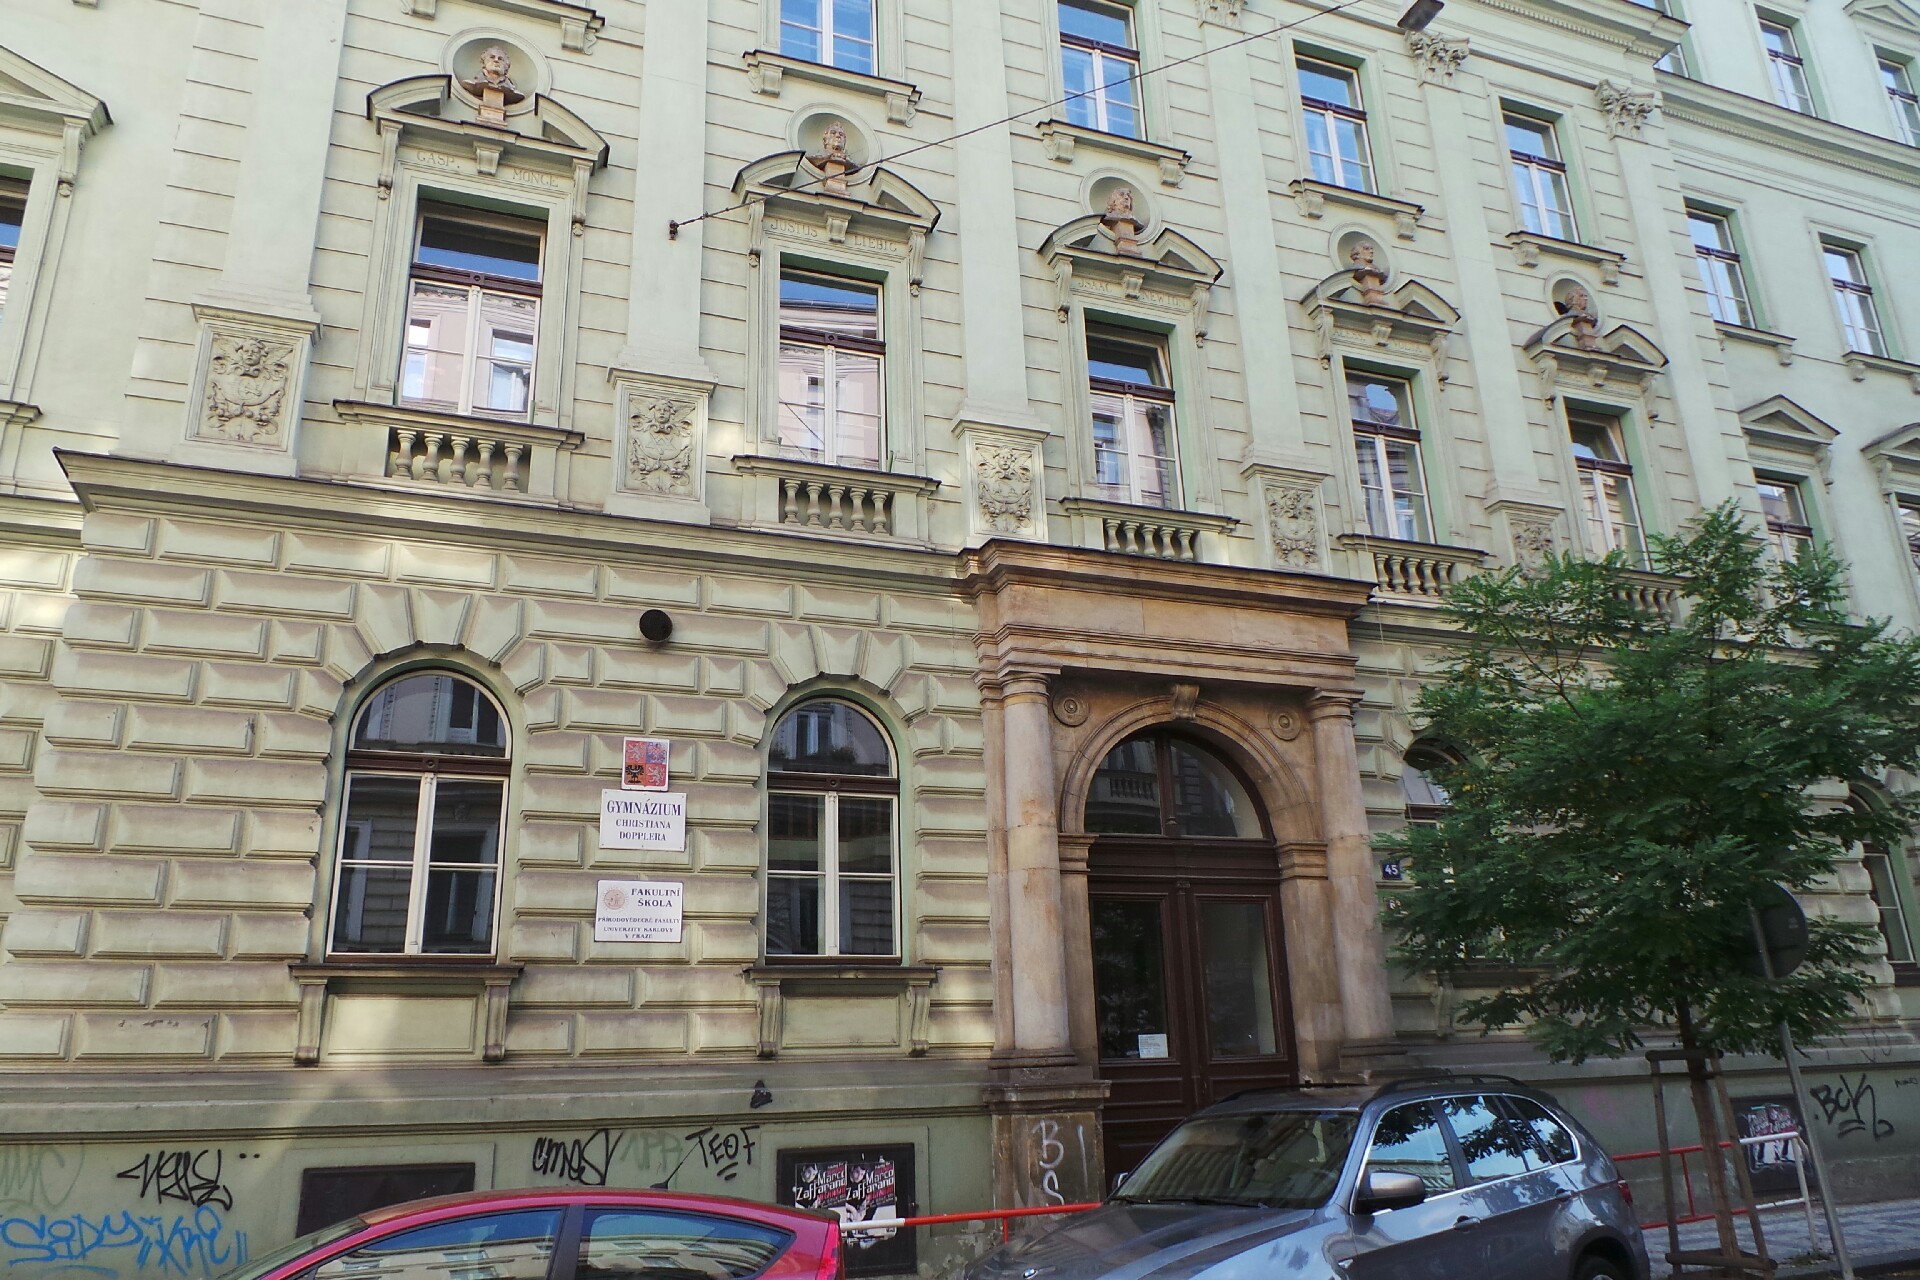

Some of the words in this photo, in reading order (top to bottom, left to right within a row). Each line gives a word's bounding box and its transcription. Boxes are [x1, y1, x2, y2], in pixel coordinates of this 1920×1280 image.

[606, 798, 682, 816] GYMNÁZIUM
[615, 819, 671, 829] CHRISTIANA
[619, 831, 666, 841] DOPPLERA
[1384, 864, 1399, 875] 45
[631, 888, 681, 897] FAKULTNÍ
[637, 898, 673, 908] ŠKOLA
[866, 1169, 894, 1187] Marco
[846, 1179, 894, 1201] Zaffarano
